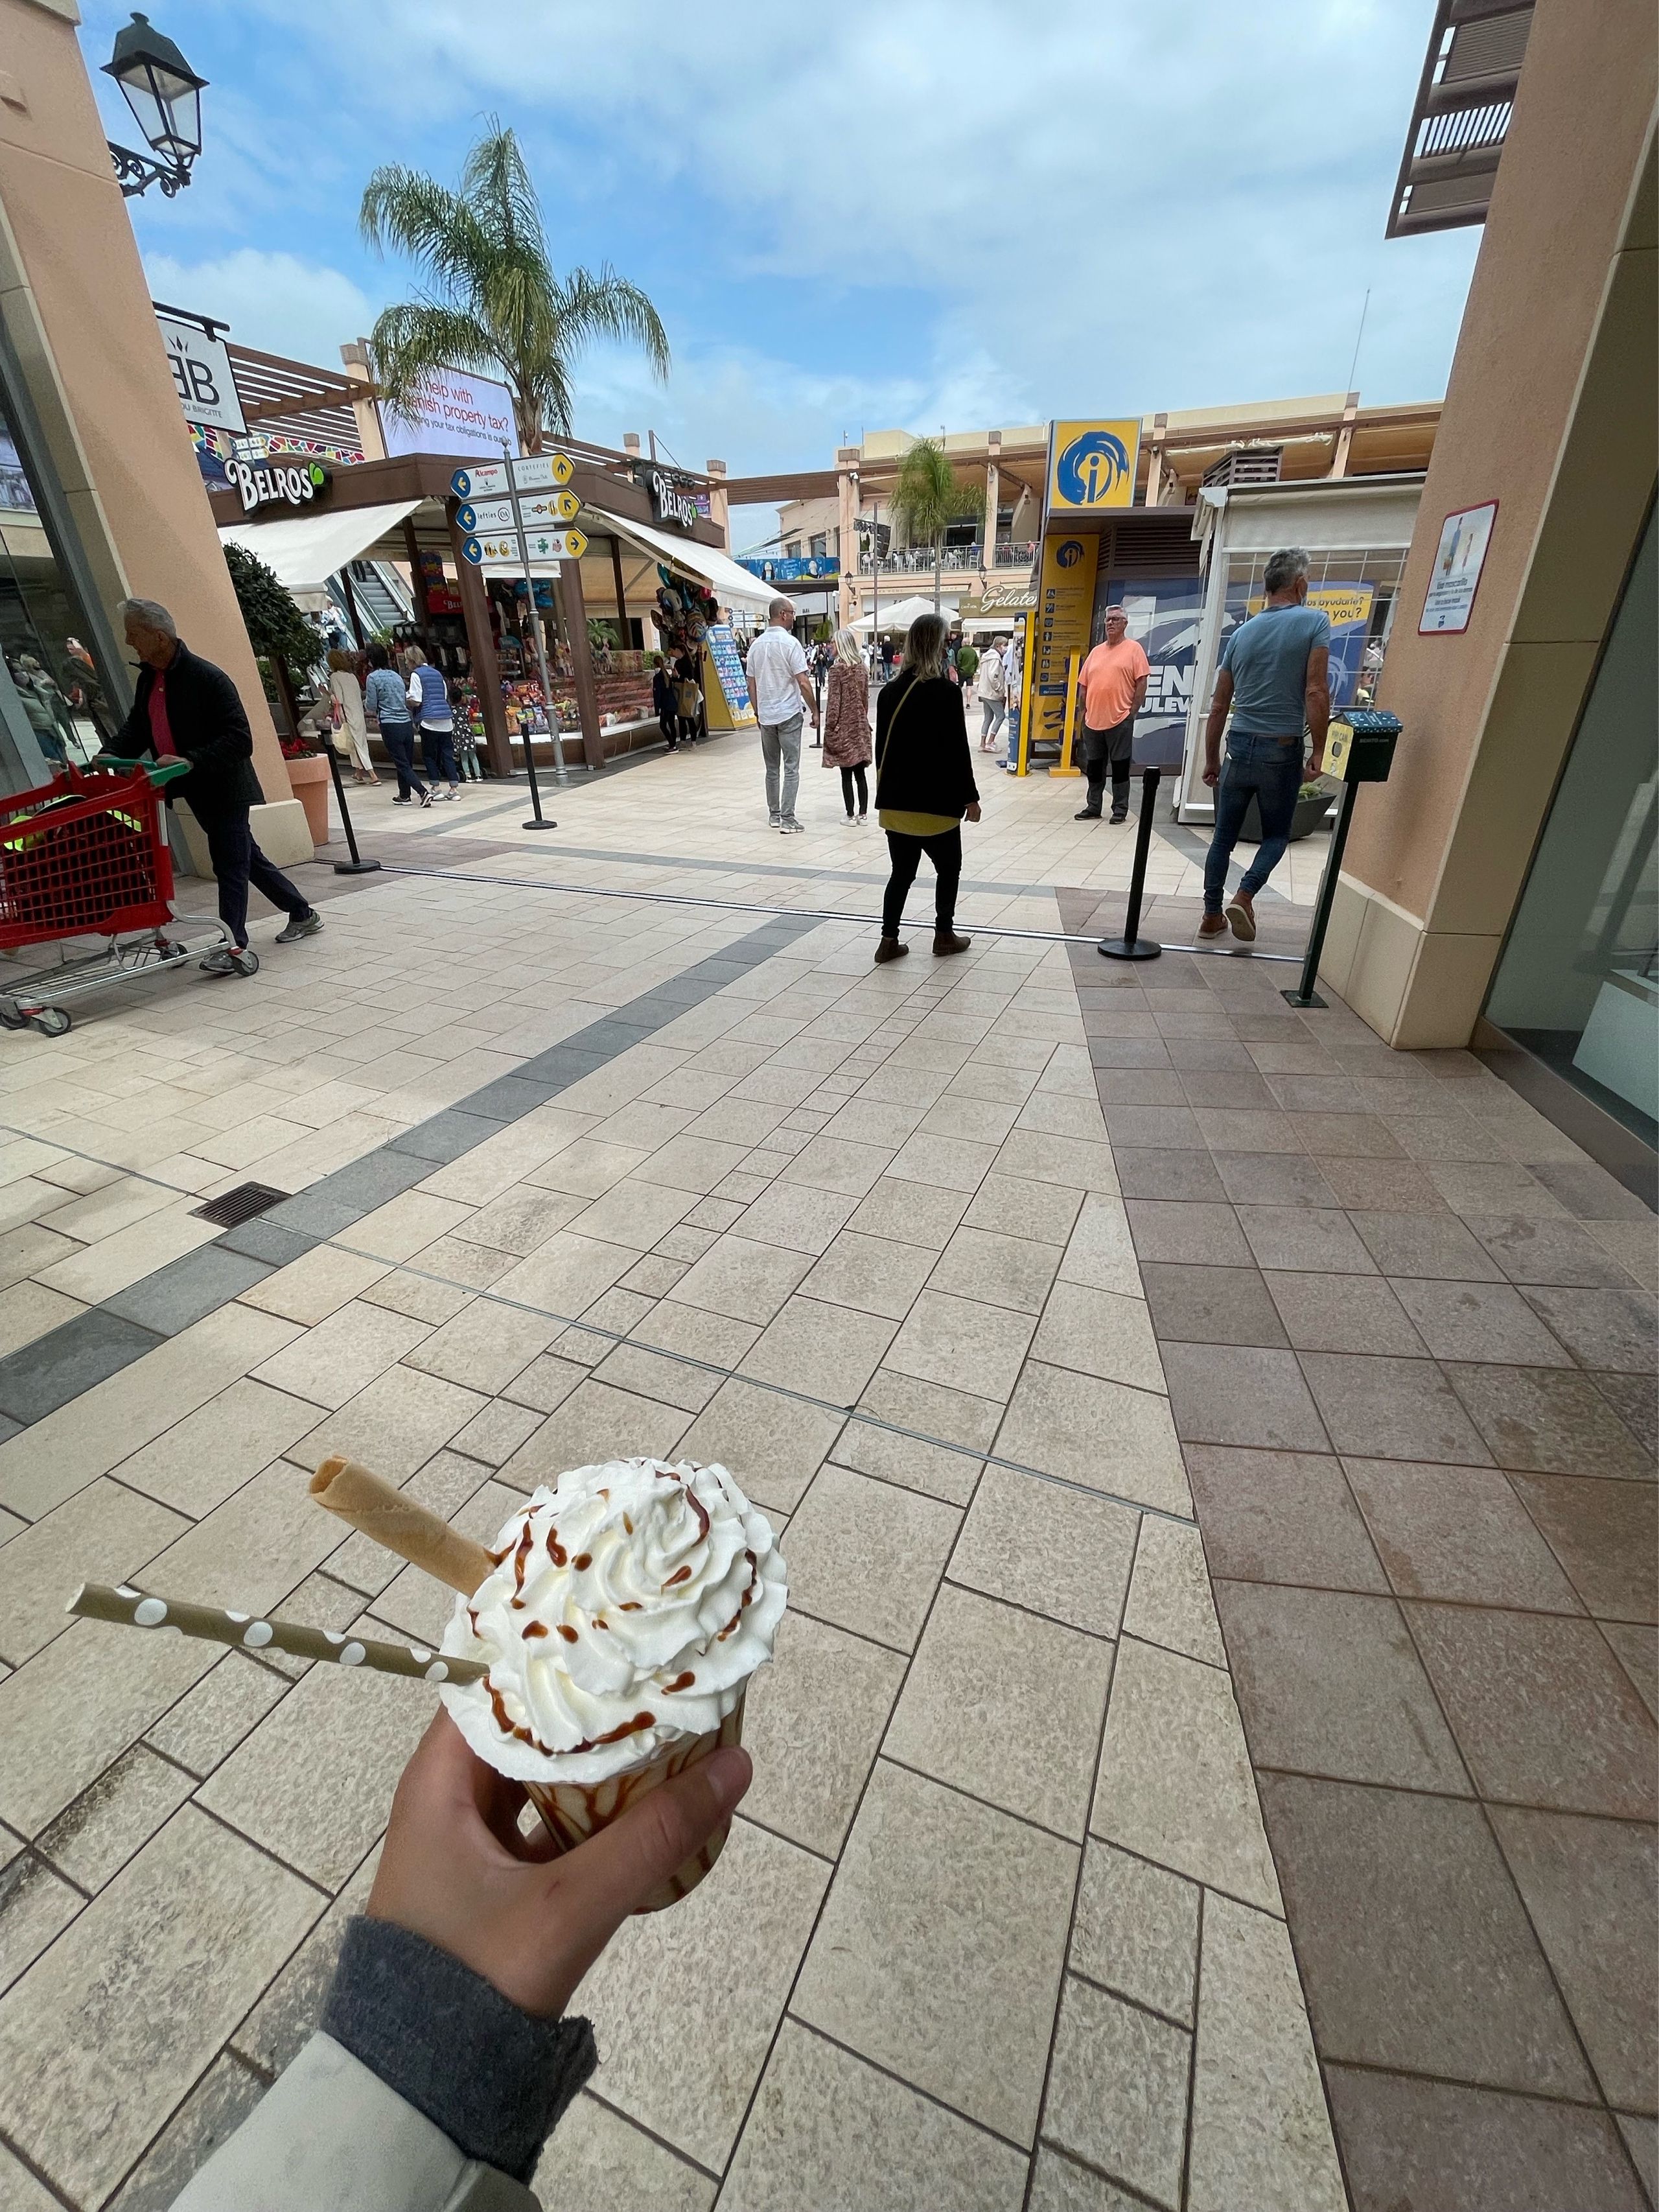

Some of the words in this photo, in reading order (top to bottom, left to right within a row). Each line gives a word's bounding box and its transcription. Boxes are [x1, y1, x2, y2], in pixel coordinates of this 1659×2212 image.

[425, 380, 449, 401] help
[451, 386, 474, 405] with
[406, 393, 441, 415] anish
[443, 403, 486, 430] property
[488, 413, 509, 432] tax?
[430, 420, 445, 429] your
[445, 422, 454, 432] tax
[456, 424, 487, 439] obligations
[475, 468, 498, 478] Alcampo
[224, 458, 314, 511] BELROS
[652, 471, 693, 528] BELROS
[477, 507, 497, 520] lefties
[1332, 607, 1362, 621] you?
[1144, 665, 1196, 696] EN
[1138, 697, 1190, 713] ULEV
